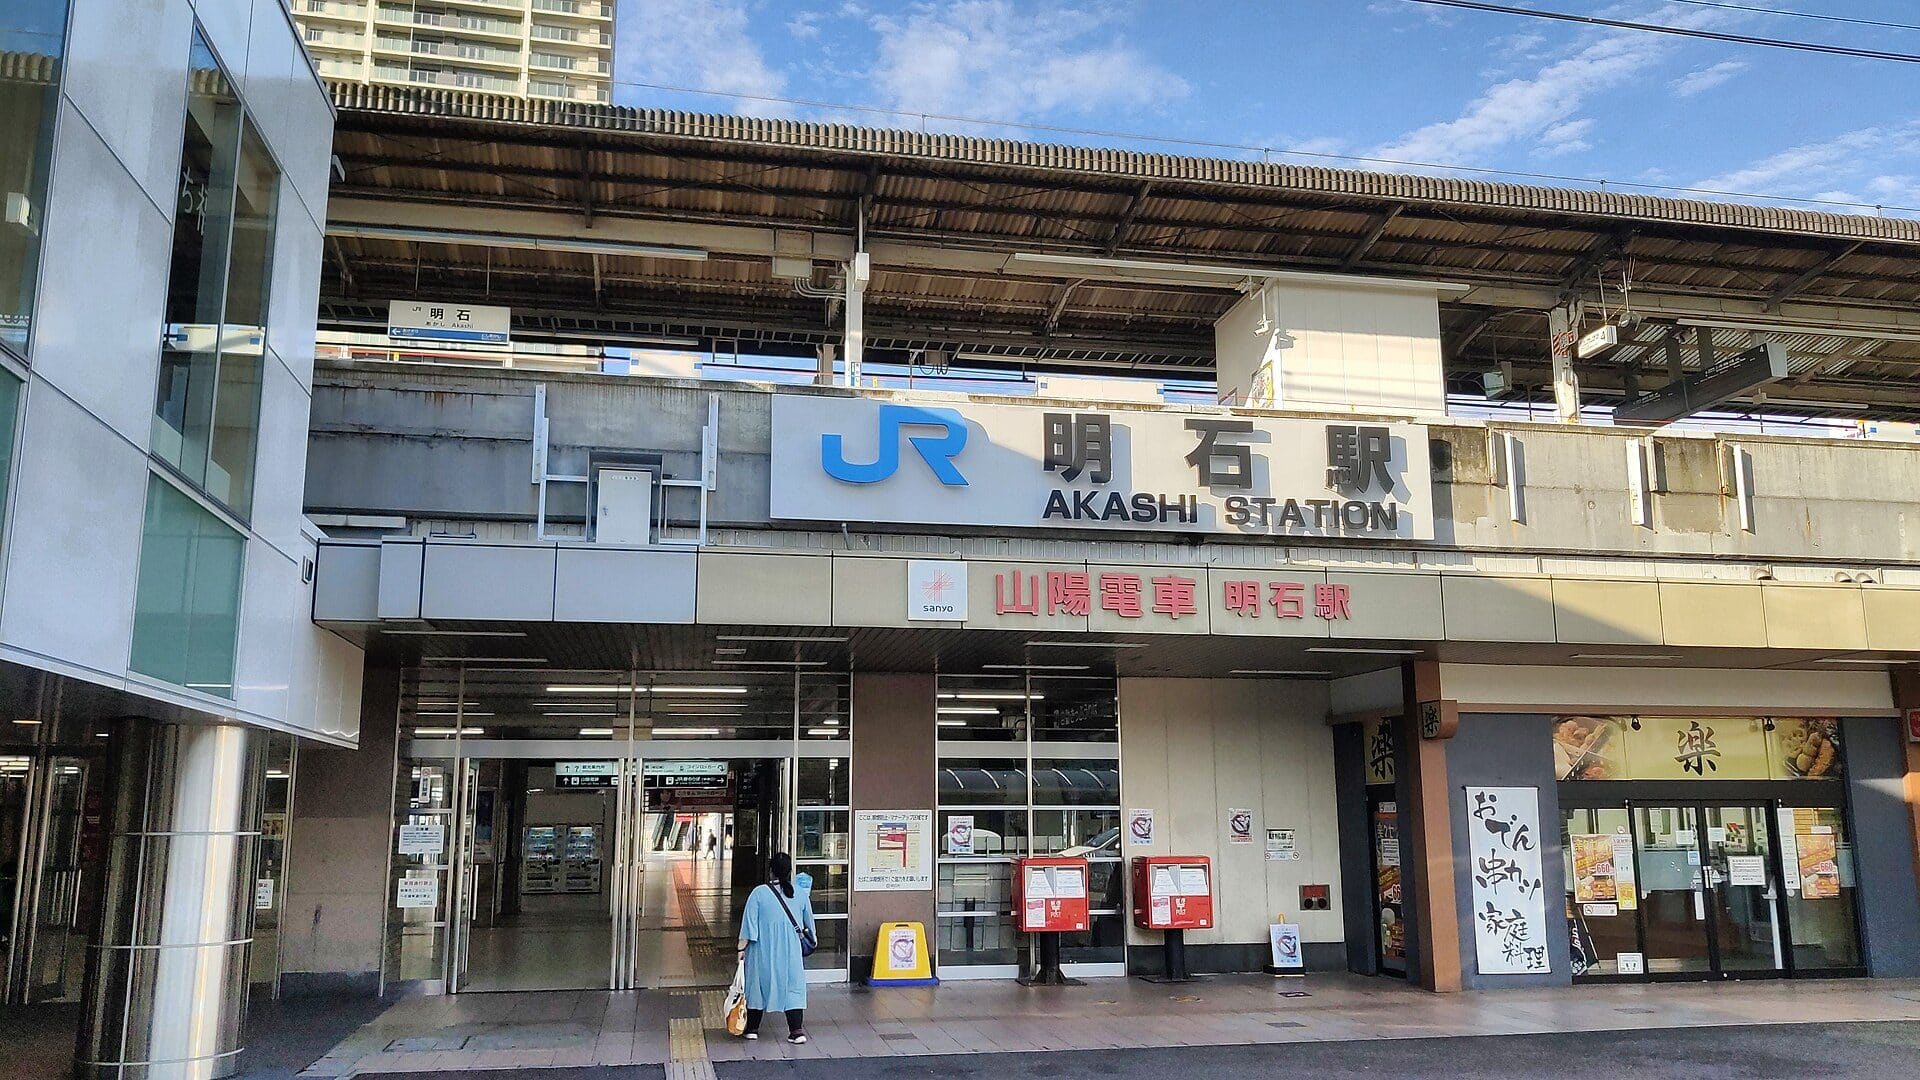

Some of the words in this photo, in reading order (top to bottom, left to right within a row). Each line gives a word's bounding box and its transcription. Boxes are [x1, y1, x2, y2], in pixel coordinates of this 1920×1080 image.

[430, 307, 472, 321] 明石
[821, 404, 970, 486] JR
[1043, 412, 1395, 495] 明石駅
[1042, 489, 1199, 525] AKASHI
[1224, 495, 1398, 531] STATION
[922, 603, 954, 613] sanyo
[995, 569, 1198, 620] 山陽電車
[1223, 580, 1352, 620] 明石駅
[1423, 705, 1440, 735] 楽
[1674, 720, 1722, 777] 楽
[1474, 791, 1537, 852] おでん
[1475, 848, 1541, 901] 串カツ
[1597, 863, 1610, 873] 660
[1820, 862, 1833, 872] 660
[1478, 900, 1546, 970] 家庭料理
